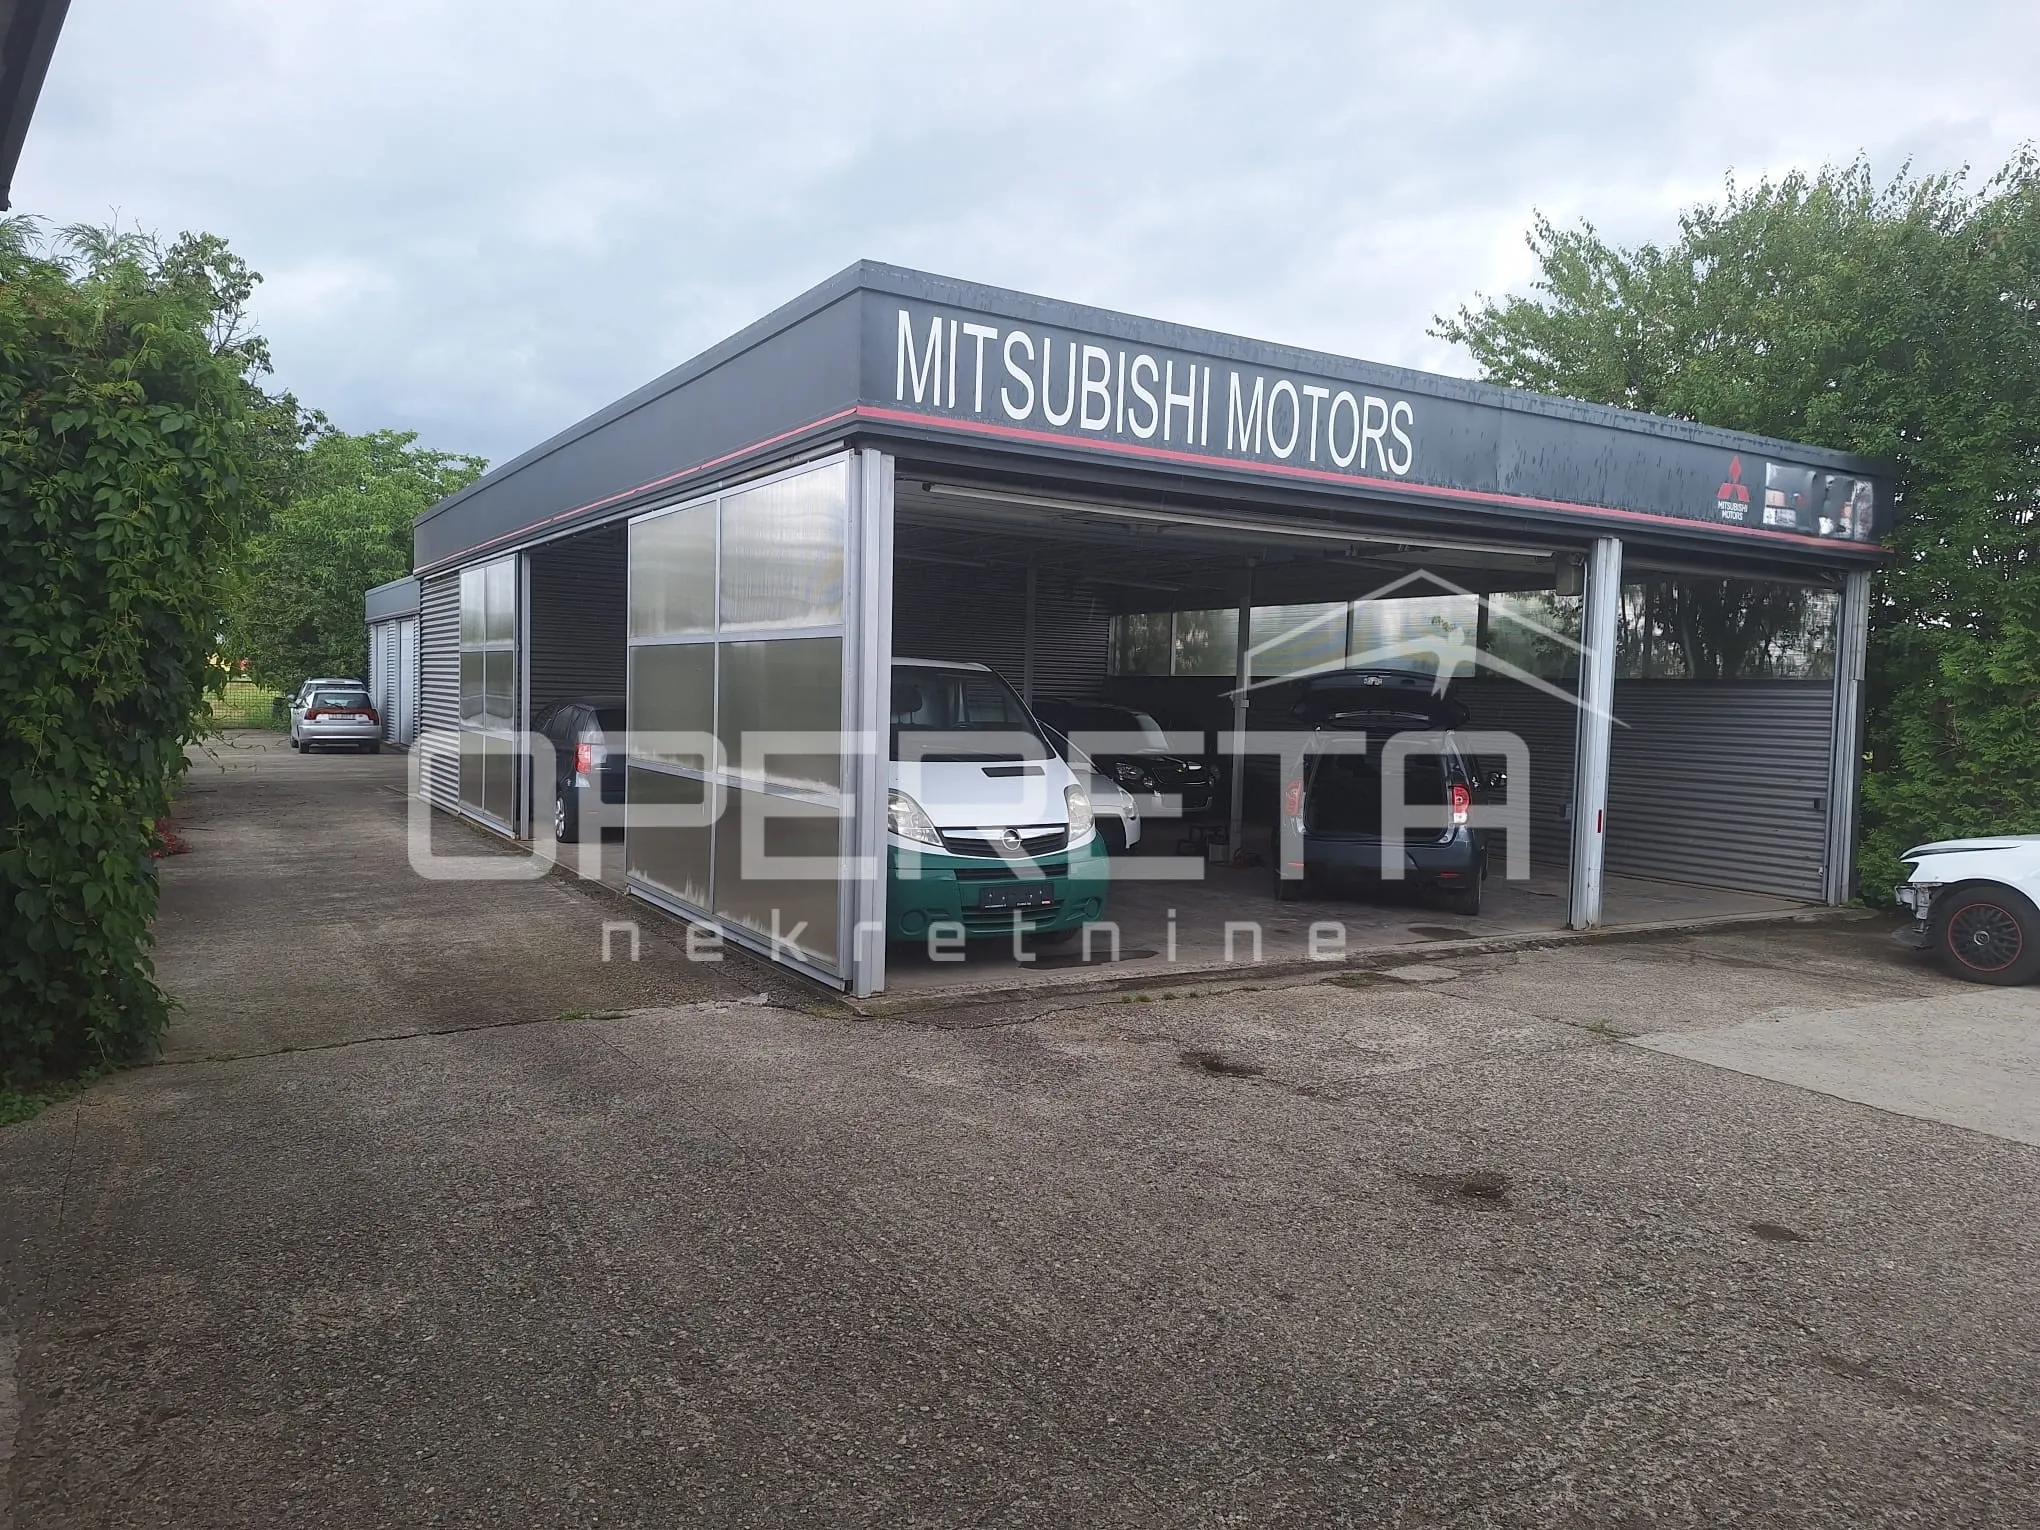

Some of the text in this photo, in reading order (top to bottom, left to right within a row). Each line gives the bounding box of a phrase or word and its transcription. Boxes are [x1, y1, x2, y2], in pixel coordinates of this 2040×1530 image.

[896, 309, 1414, 475] MITSUBISHI MOTORS
[1717, 500, 1748, 512] MITSUBISHI
[1721, 510, 1744, 520] MOTORS
